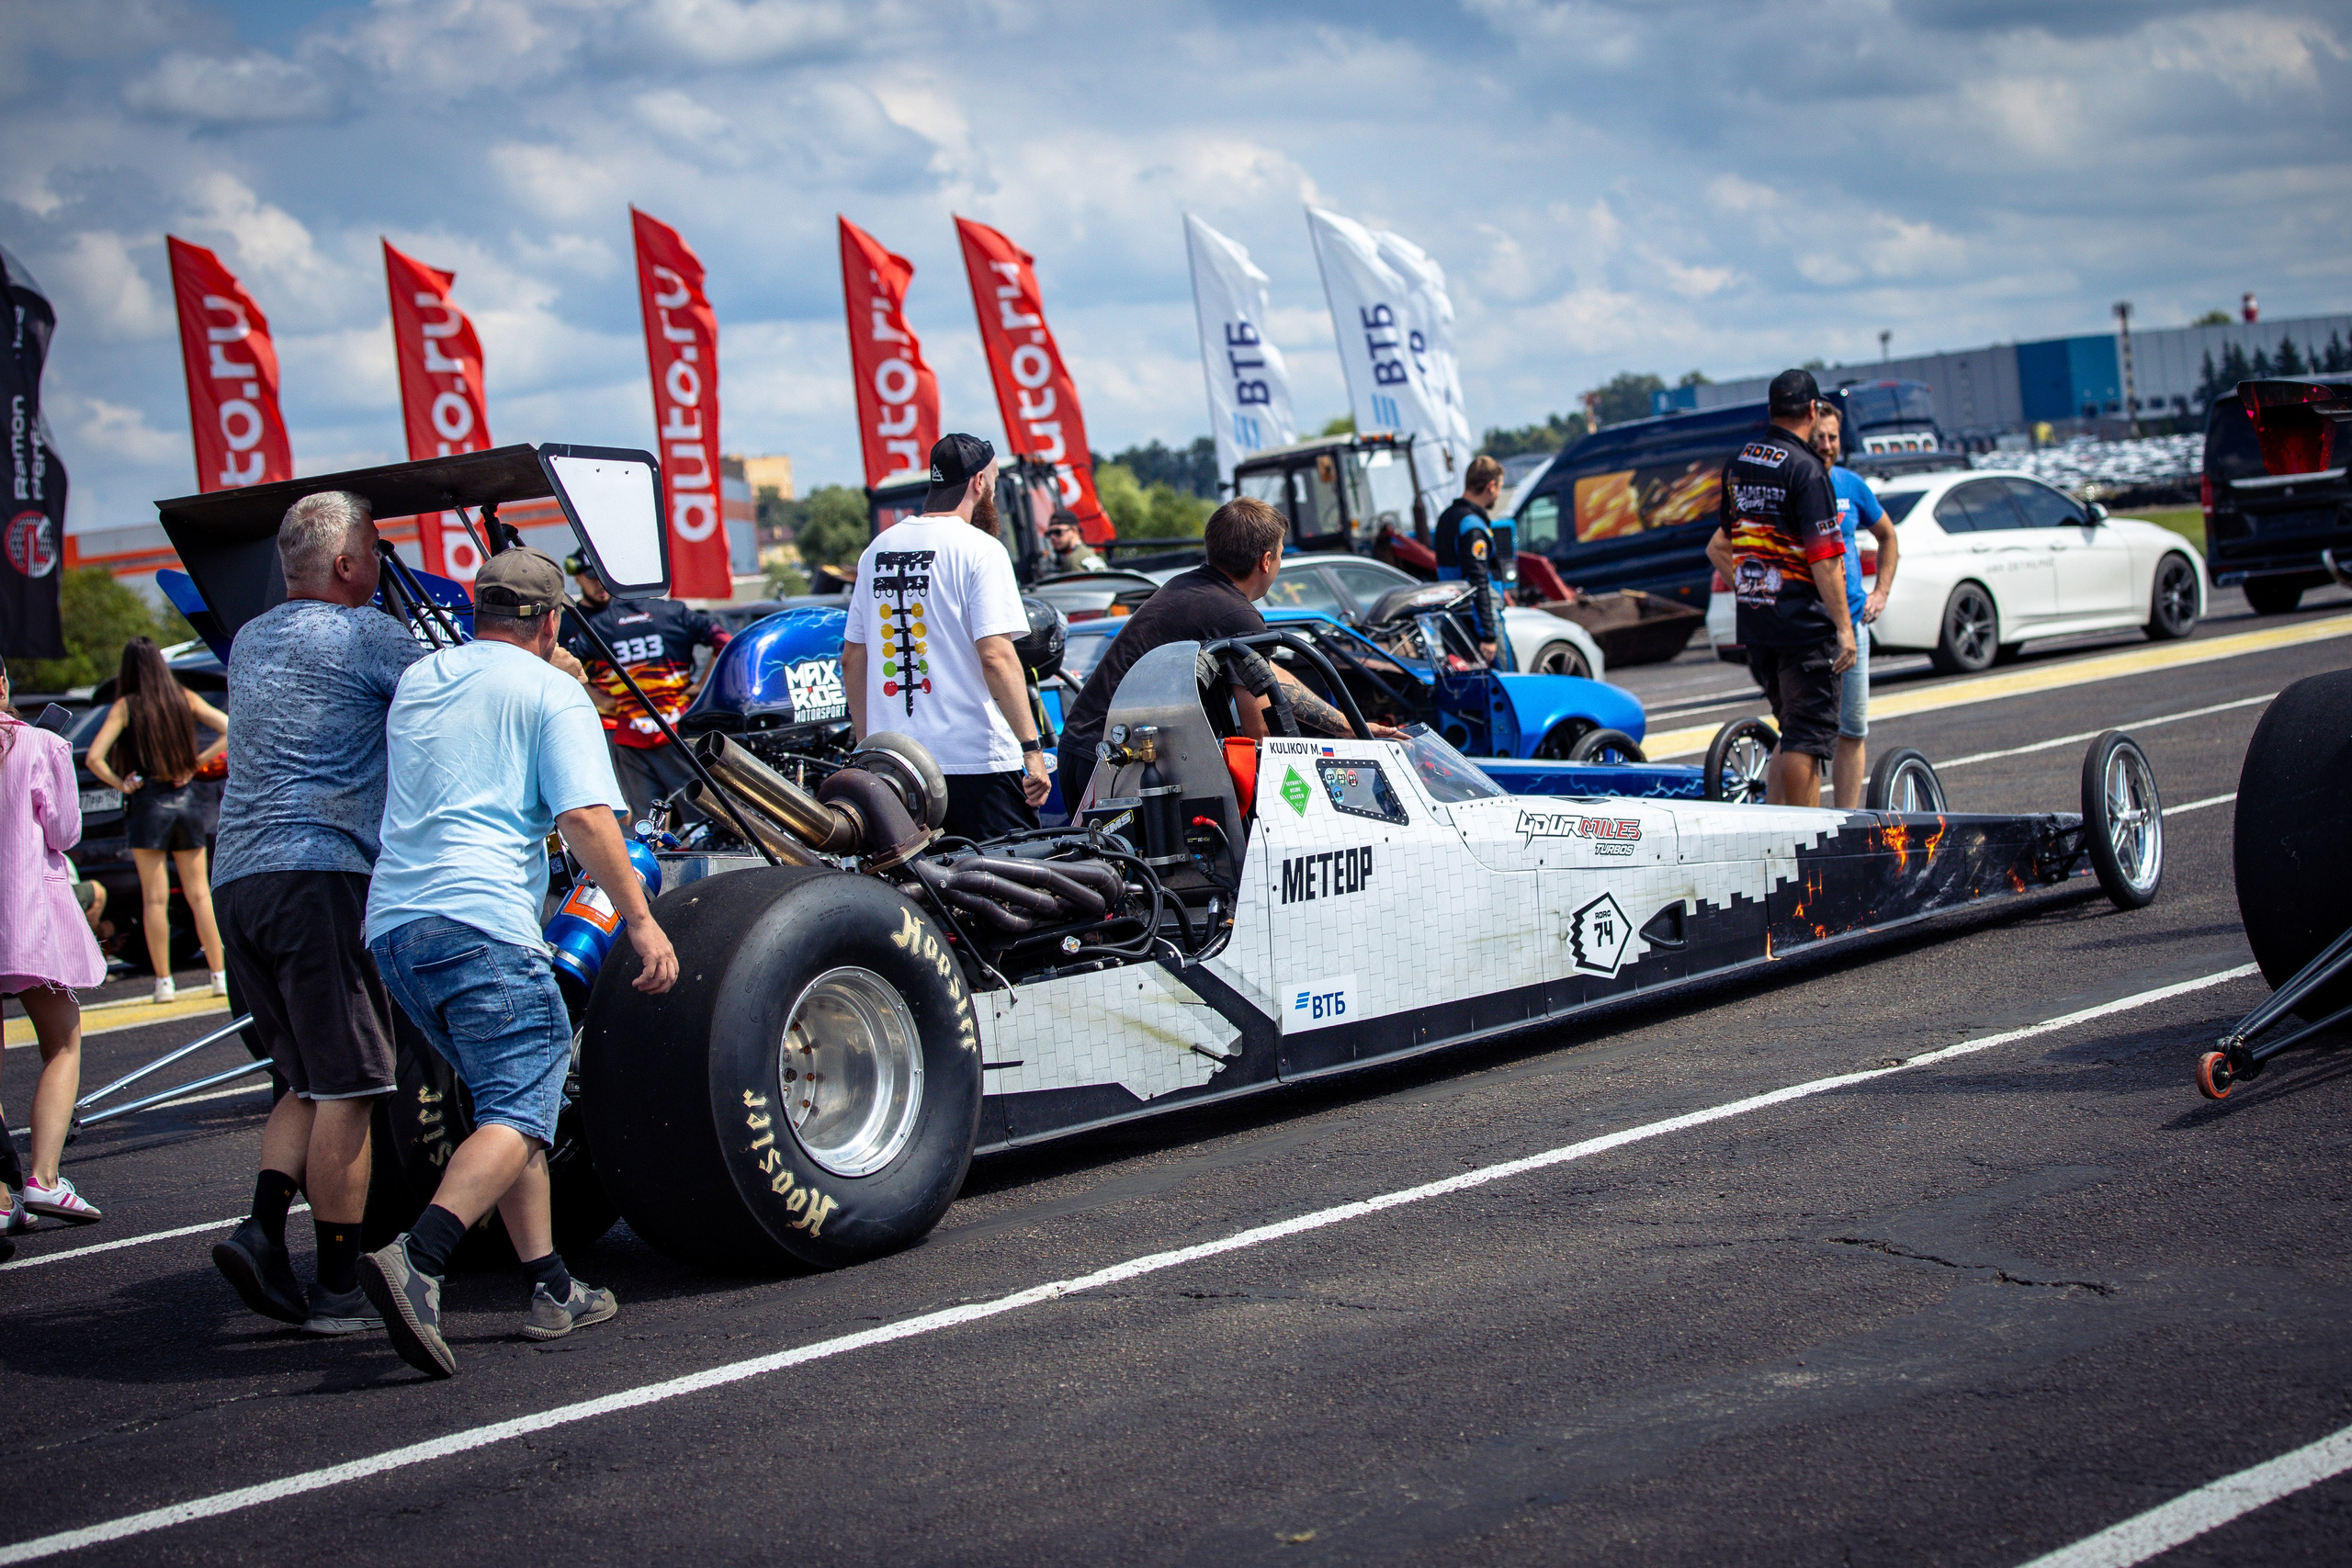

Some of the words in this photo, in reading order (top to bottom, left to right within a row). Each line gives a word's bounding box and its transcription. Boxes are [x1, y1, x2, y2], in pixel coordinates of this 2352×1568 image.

[870, 269, 922, 478] uto.ru
[1224, 321, 1271, 406] ВТБ
[1361, 302, 1408, 386] ВТБ
[202, 293, 266, 487] to.ru
[653, 264, 718, 543] auto.ru
[11, 395, 28, 500] Ramon
[612, 634, 665, 663] 333
[784, 660, 842, 689] MAX
[794, 705, 846, 724] MOTORSPORT
[1270, 742, 1308, 754] KULIKOV
[1310, 743, 1322, 755] M.
[1282, 845, 1373, 905] МЕТЕОР
[1595, 842, 1634, 855] TURBOS
[1594, 919, 1614, 947] 74
[1312, 991, 1346, 1020] ВТБ
[742, 1089, 840, 1238] Hoosier
